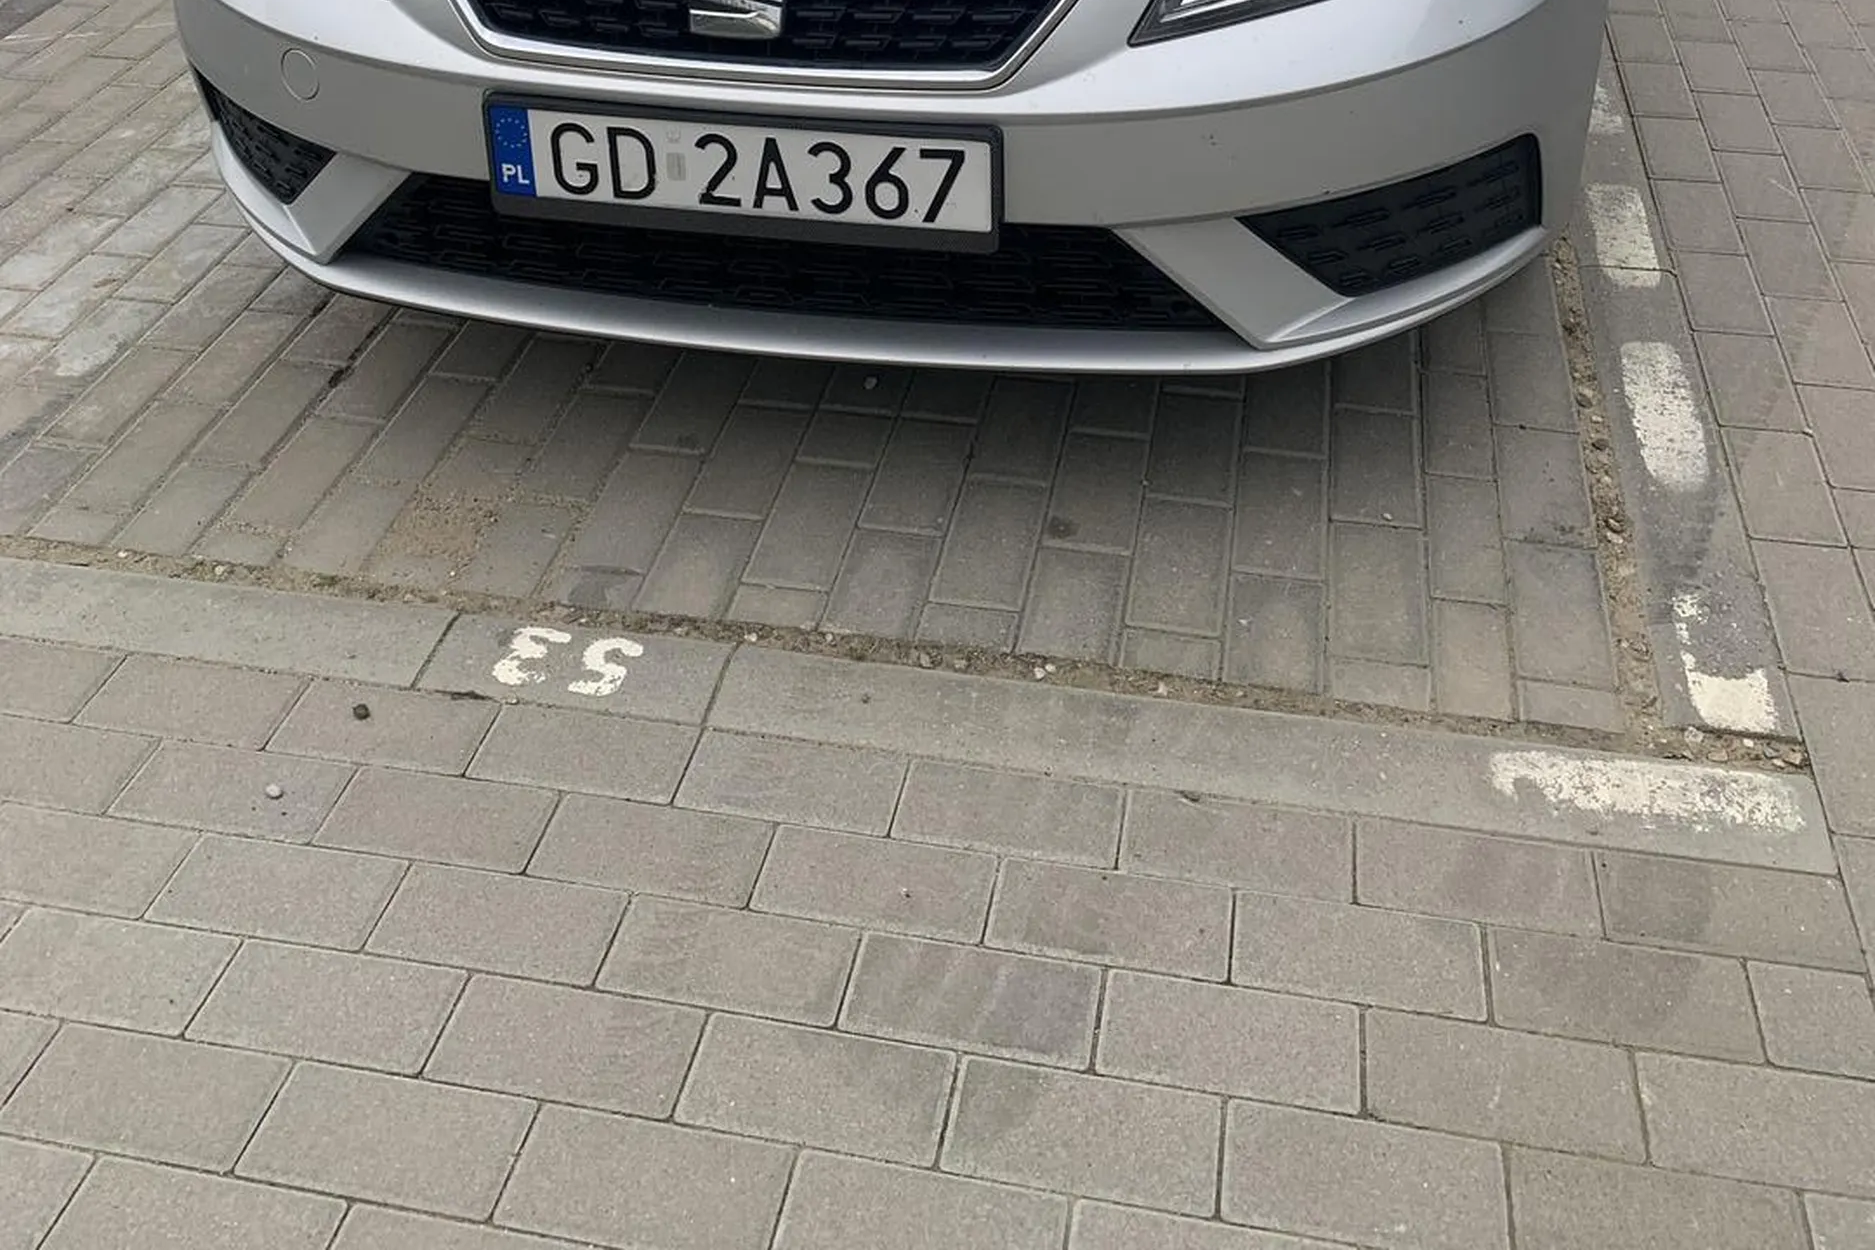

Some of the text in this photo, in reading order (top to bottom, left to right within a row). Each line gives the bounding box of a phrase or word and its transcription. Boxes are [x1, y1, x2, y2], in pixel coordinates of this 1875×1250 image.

[501, 163, 531, 184] PL
[550, 122, 966, 224] GD 2A367
